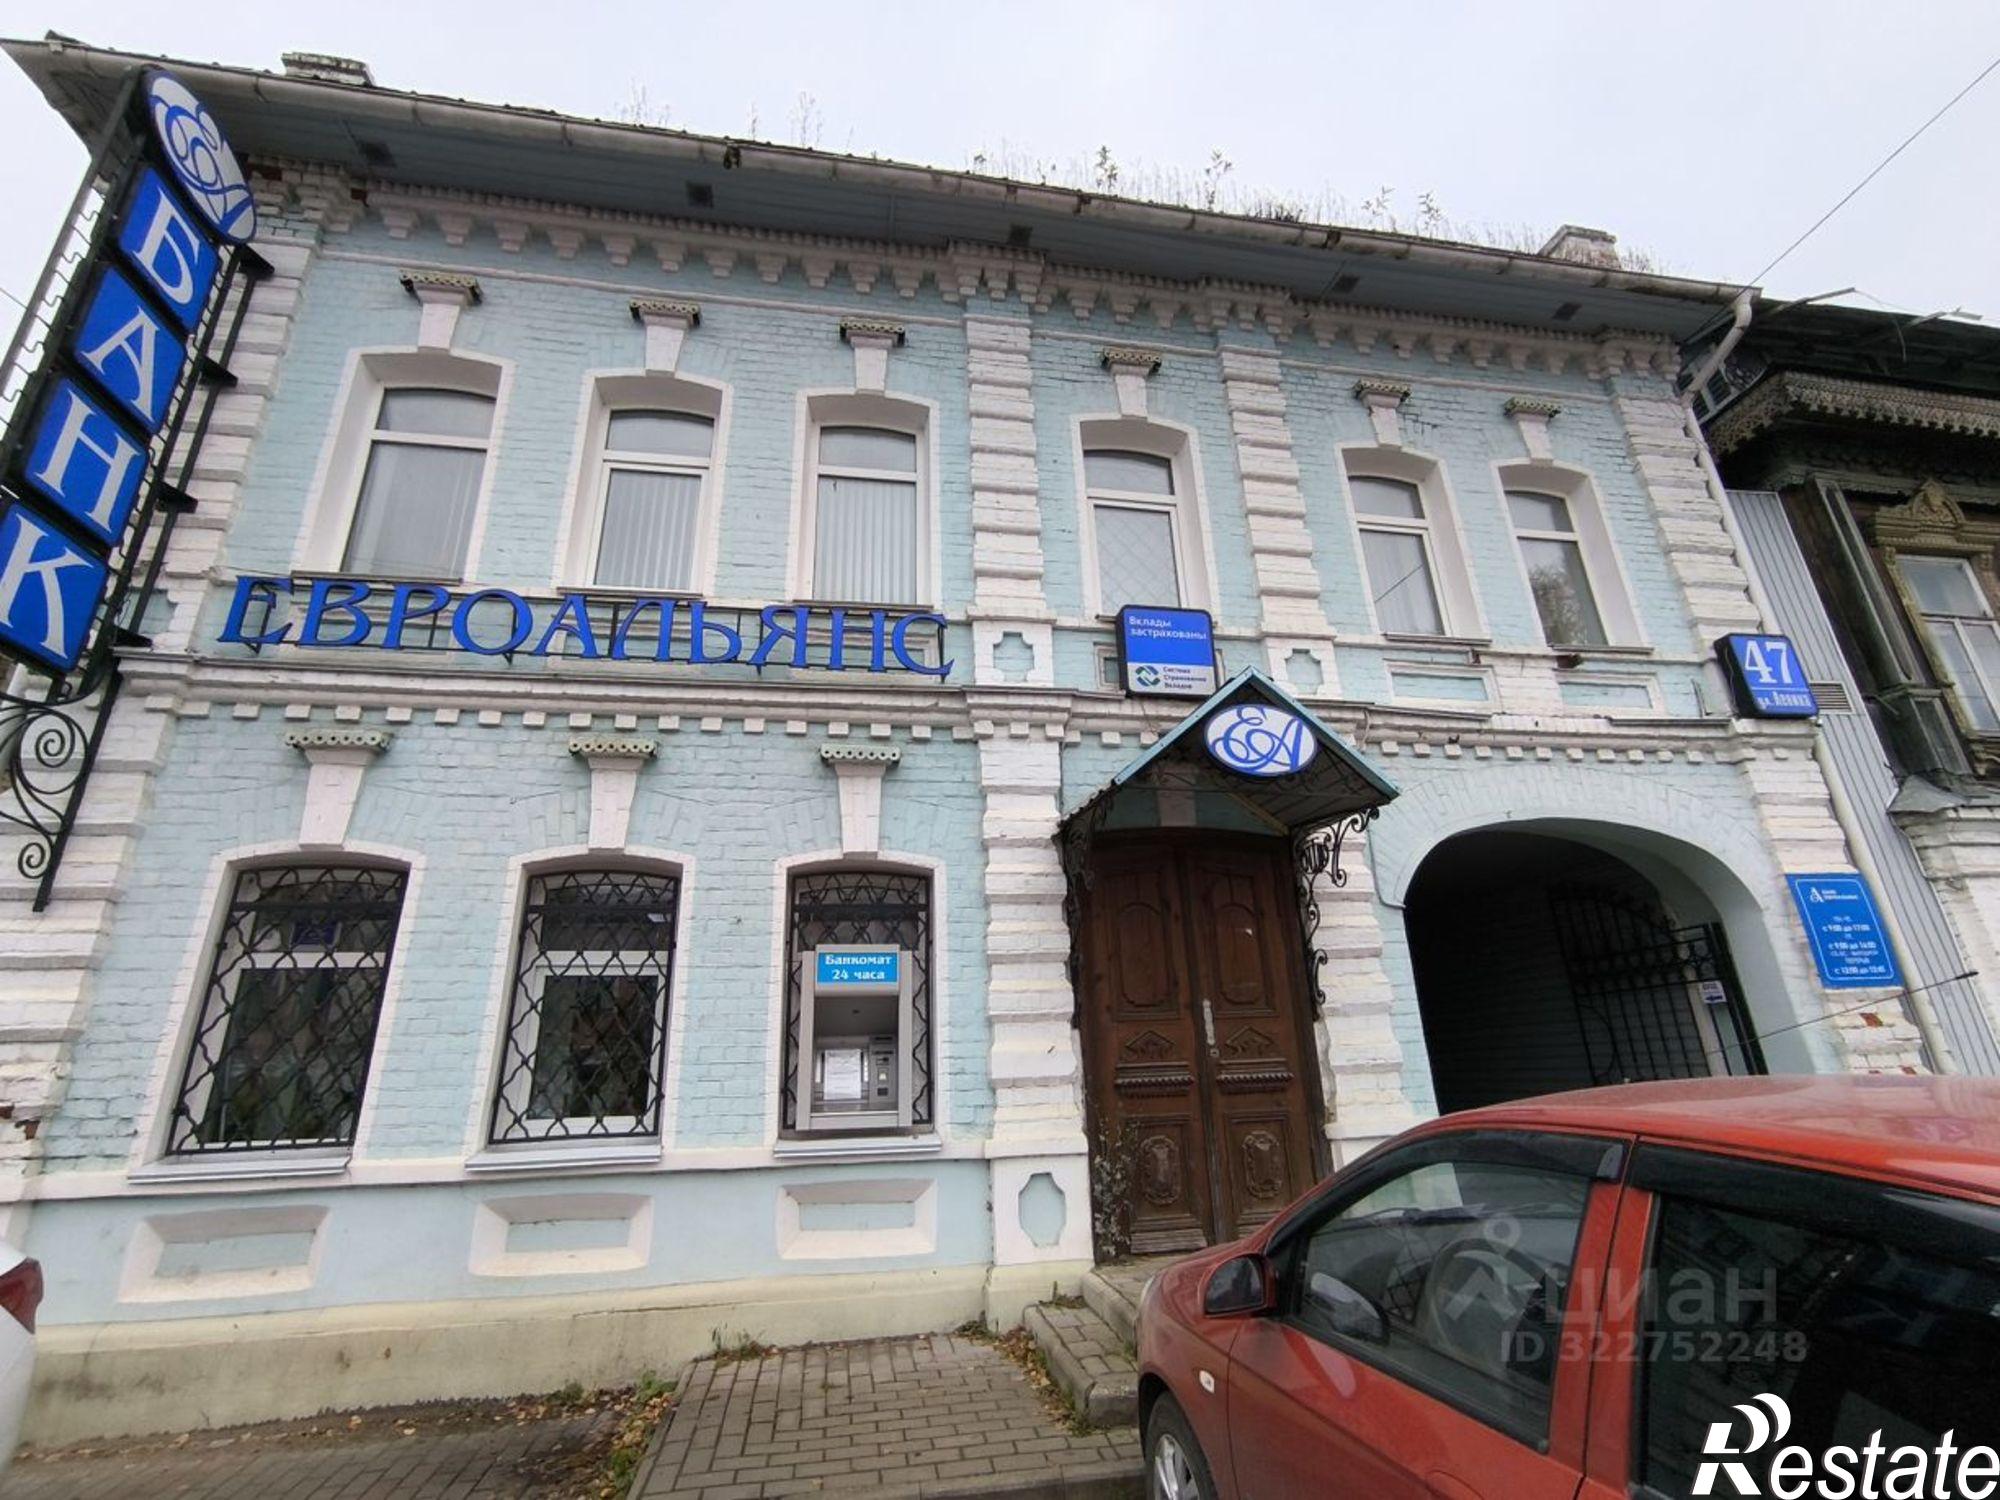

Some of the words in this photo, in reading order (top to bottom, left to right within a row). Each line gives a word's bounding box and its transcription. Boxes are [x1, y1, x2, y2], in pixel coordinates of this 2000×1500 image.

[0, 187, 200, 660] БАНК
[216, 575, 955, 676] ЕВРОАЛЬЯНС
[1128, 616, 1172, 628] Вклады
[1131, 628, 1207, 640] застрахованы
[1744, 640, 1793, 684] 47
[825, 954, 892, 965] Банкомат
[832, 969, 849, 980] 24
[854, 971, 885, 980] часа
